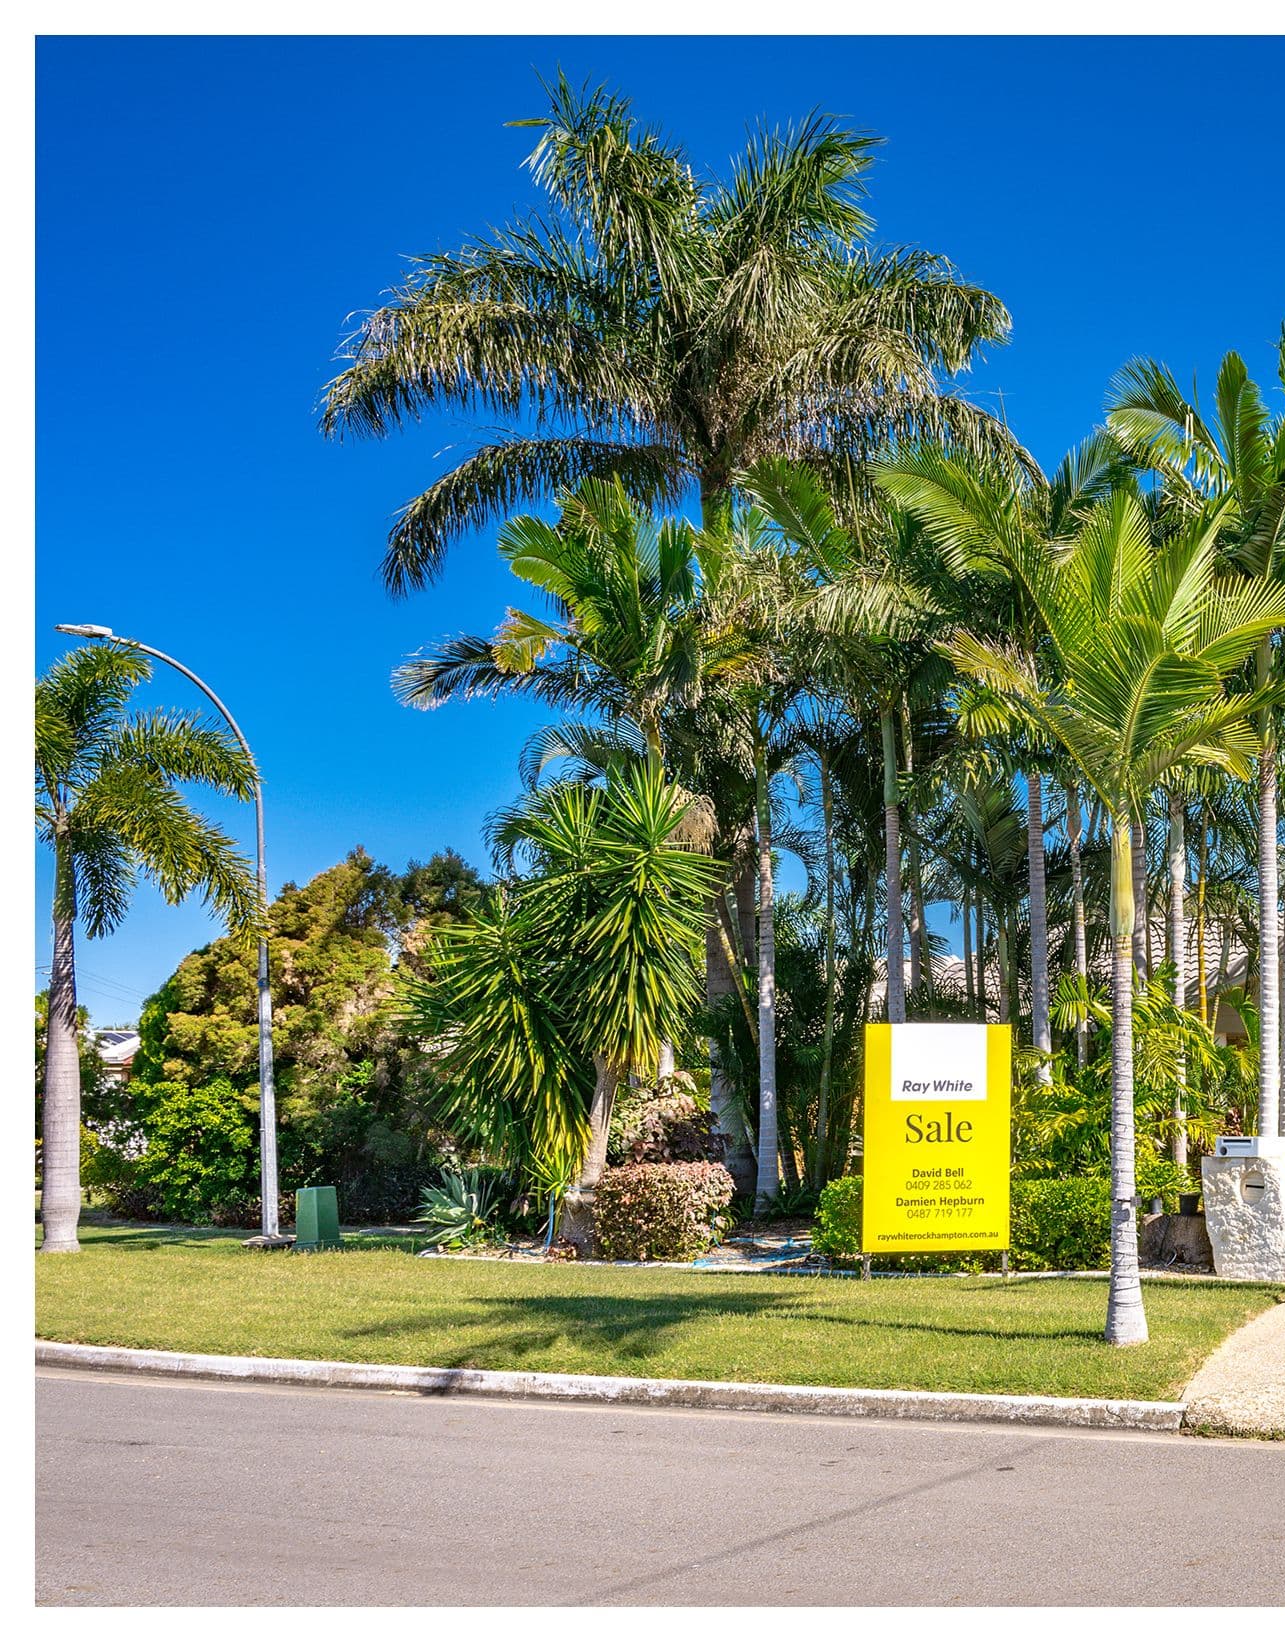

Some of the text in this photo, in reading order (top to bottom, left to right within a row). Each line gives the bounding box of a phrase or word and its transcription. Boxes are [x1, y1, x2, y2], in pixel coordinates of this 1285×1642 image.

[902, 1080, 973, 1093] Ray White
[905, 1111, 973, 1144] Sale
[912, 1168, 964, 1178] David Bell
[905, 1179, 973, 1191] 0409 285 062
[896, 1196, 985, 1208] Damien Hepburn
[906, 1207, 973, 1219] 0487 719 177
[877, 1231, 999, 1242] raywhiterockhampton.com.au
